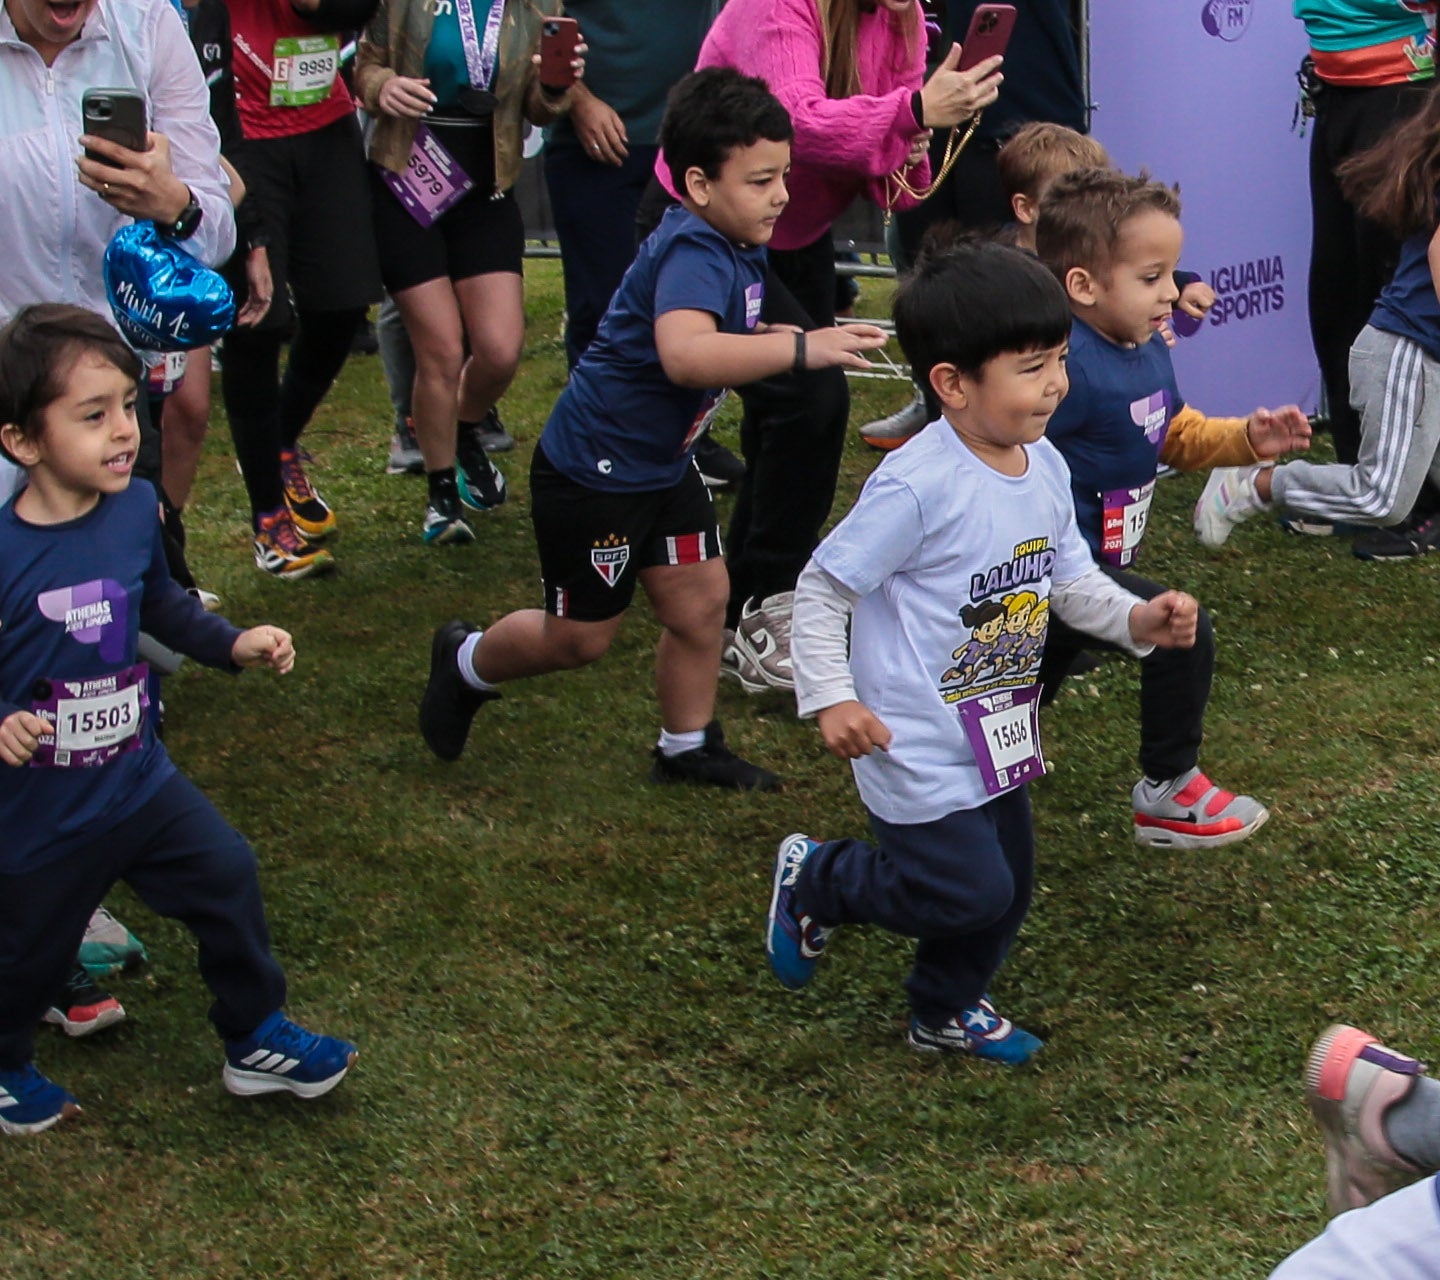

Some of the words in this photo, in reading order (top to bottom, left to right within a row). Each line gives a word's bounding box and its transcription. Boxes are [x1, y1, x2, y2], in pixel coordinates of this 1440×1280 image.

[1228, 7, 1243, 27] FM
[298, 57, 333, 77] 9993
[1211, 256, 1284, 294] IGUANA
[1210, 284, 1284, 326] SPORTS
[596, 550, 627, 562] SPFC
[1015, 537, 1048, 558] EQUIPE
[65, 600, 111, 625] ATHENAS
[68, 703, 131, 734] 15503
[993, 718, 1027, 750] 15636
